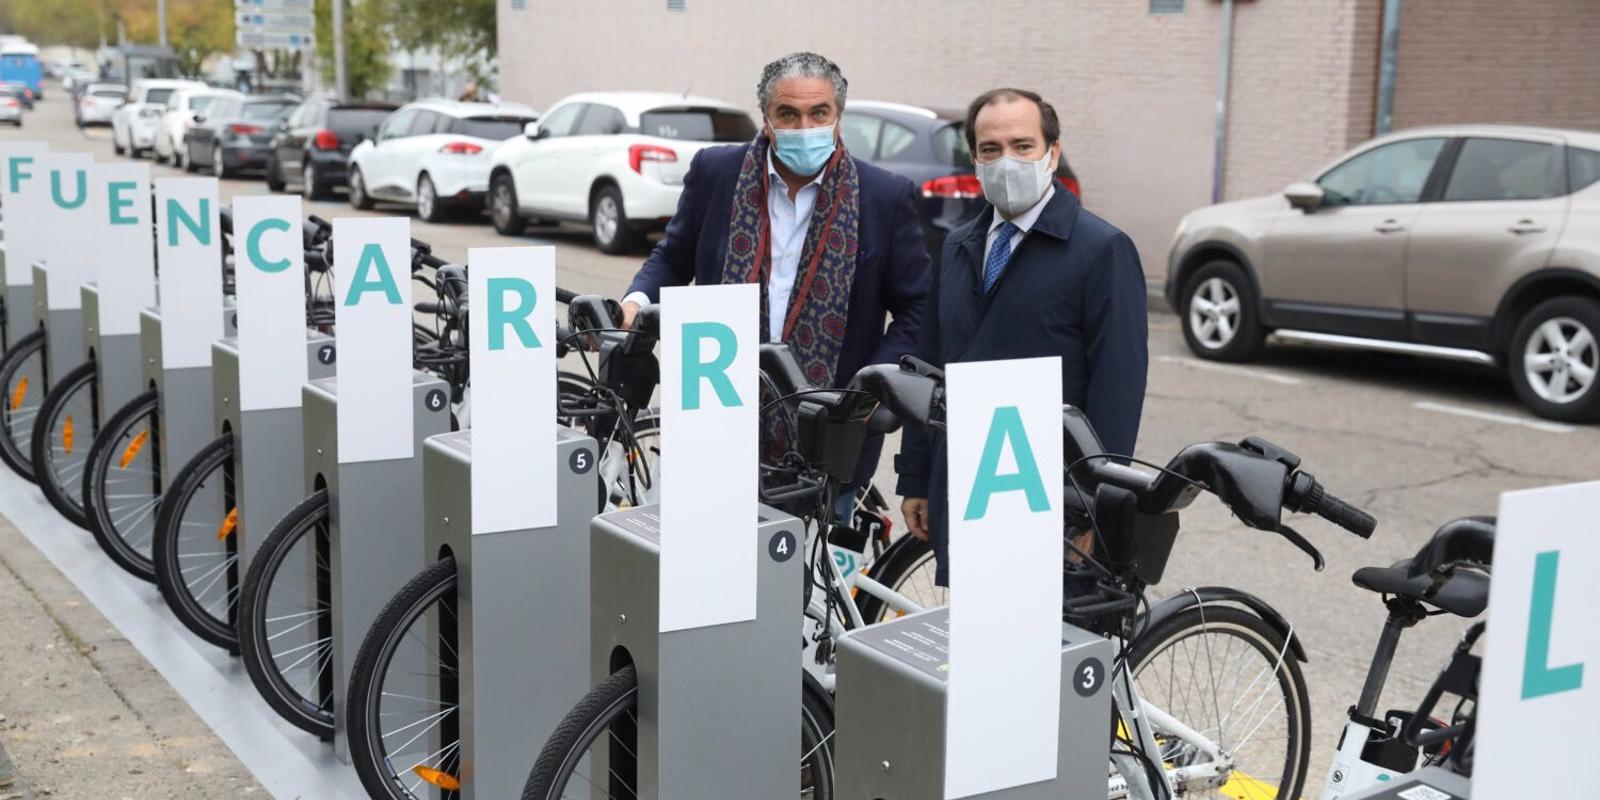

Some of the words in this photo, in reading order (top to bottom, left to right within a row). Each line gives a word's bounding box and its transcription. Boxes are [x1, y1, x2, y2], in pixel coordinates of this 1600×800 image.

[323, 349, 332, 361] 7
[431, 393, 441, 408] 6
[9, 157, 33, 193] F
[51, 170, 87, 209] U
[108, 181, 138, 225] E
[167, 198, 211, 246] N
[246, 218, 291, 273] C
[345, 243, 402, 307] A
[487, 277, 542, 351] R
[681, 322, 743, 411] R
[964, 406, 1051, 521] A
[1521, 550, 1584, 700] L
[577, 453, 587, 469] 5
[776, 536, 788, 555] 4
[1082, 665, 1095, 689] 3
